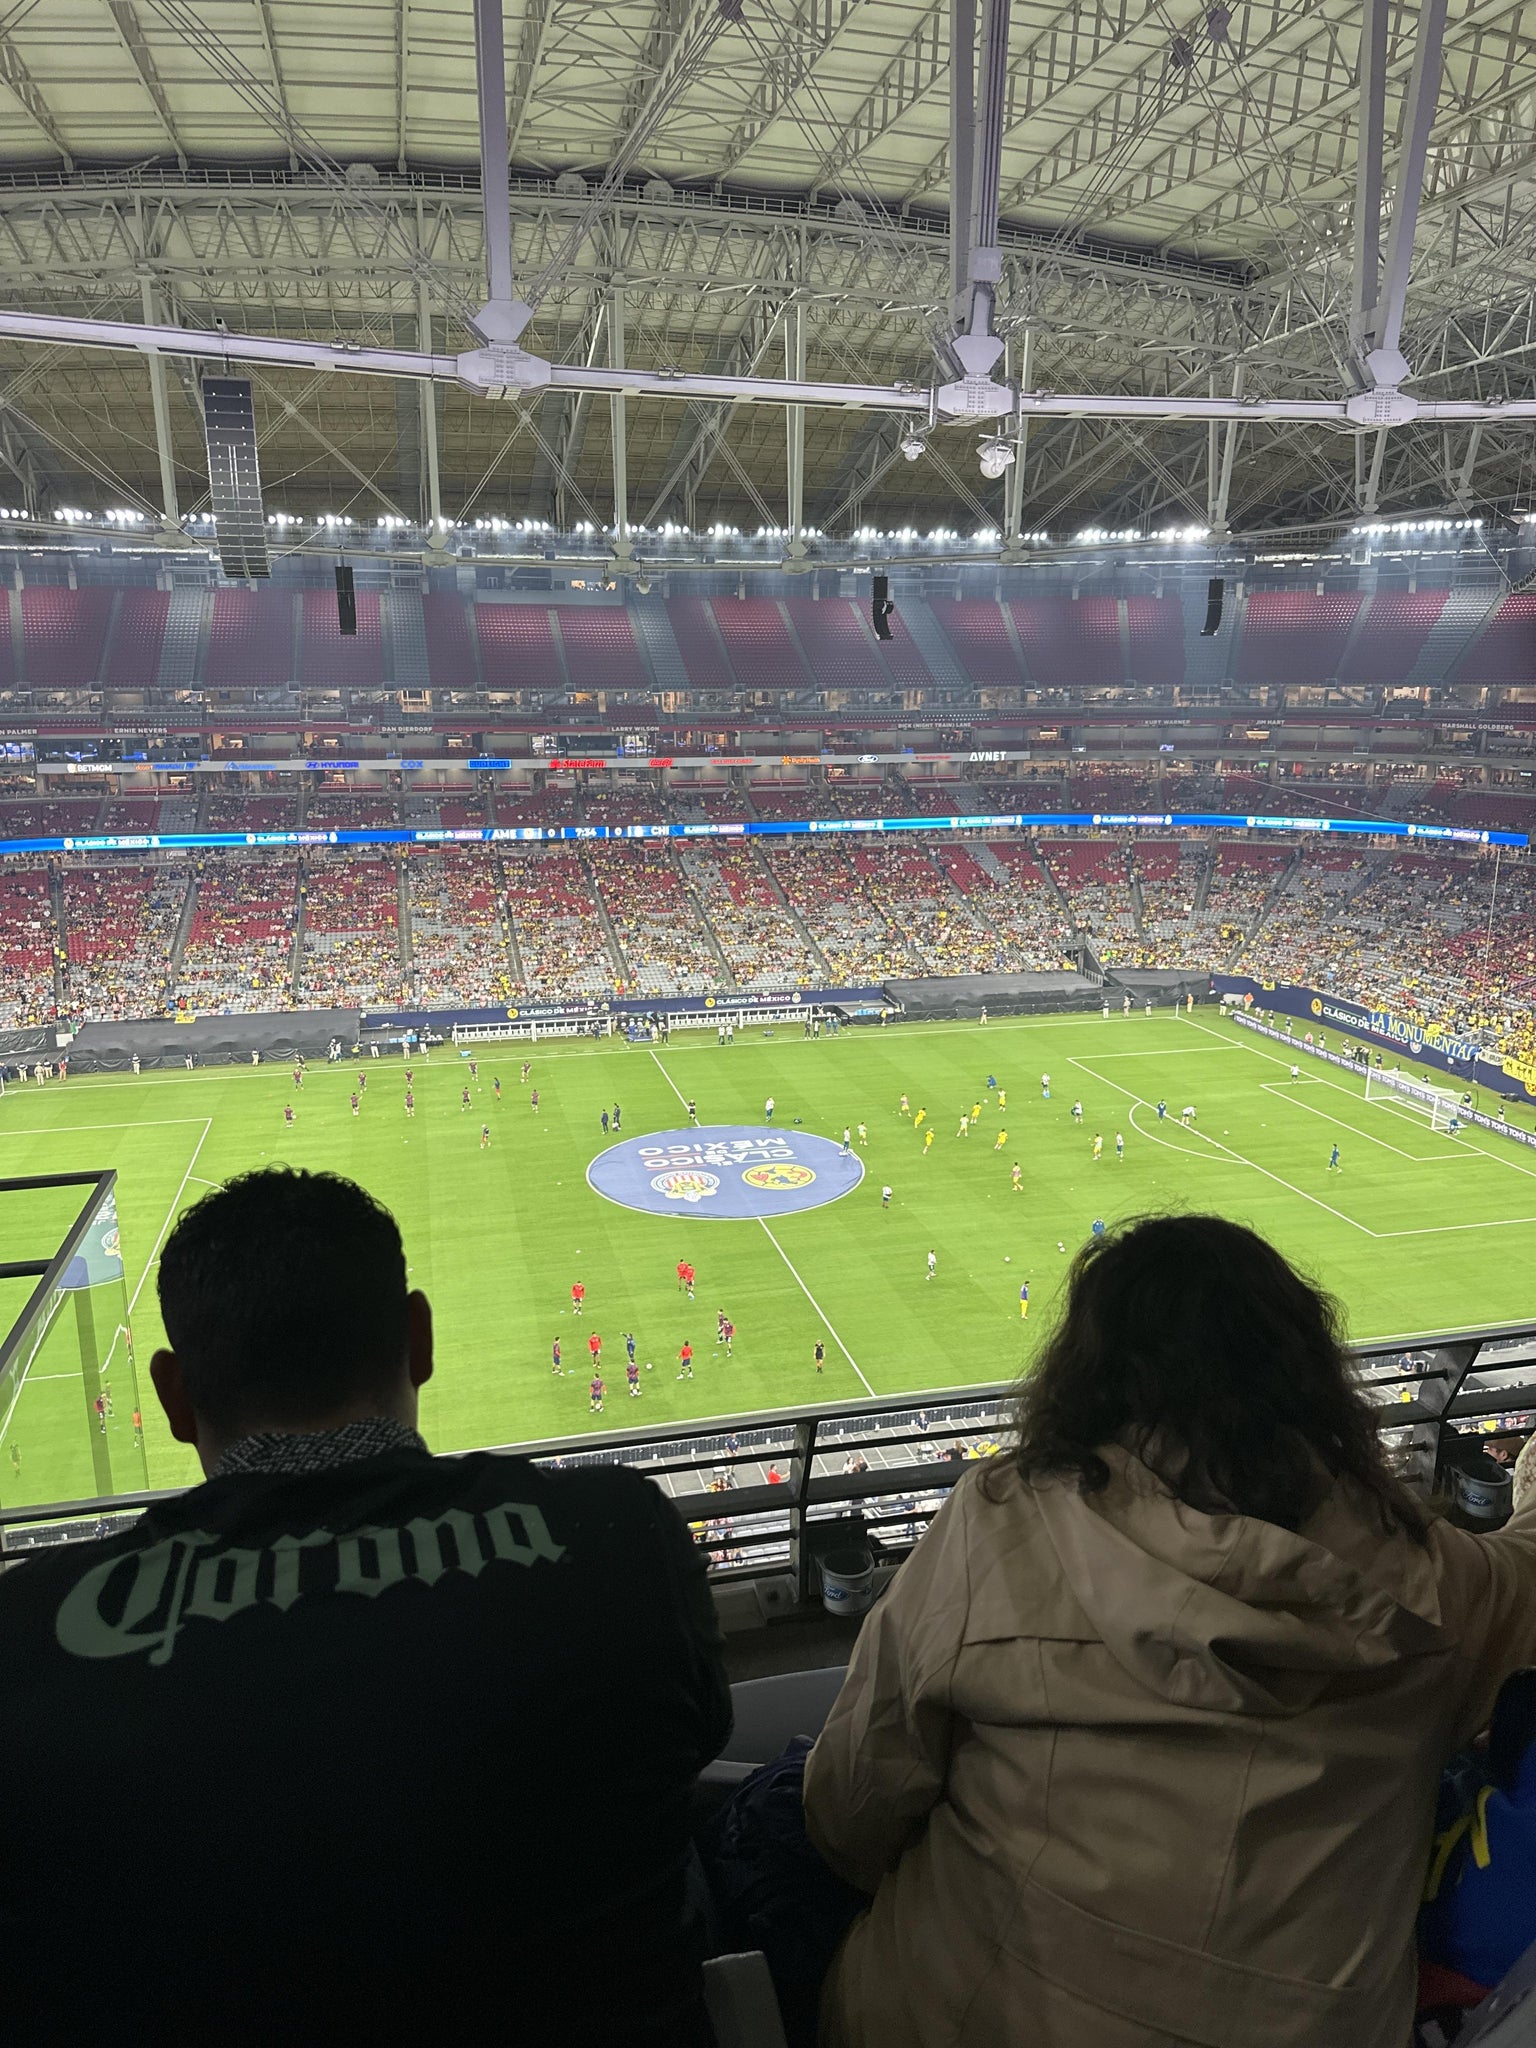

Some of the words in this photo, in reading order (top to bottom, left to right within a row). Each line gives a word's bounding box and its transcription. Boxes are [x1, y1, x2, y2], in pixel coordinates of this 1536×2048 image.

[77, 764, 113, 772] BETMGM
[320, 761, 360, 769] HYUNDAI
[400, 760, 424, 769] COX
[492, 829, 517, 840] AME
[548, 828, 556, 837] 0
[651, 825, 669, 835] CHI
[716, 997, 748, 1005] CLÁSICO
[759, 995, 791, 1003] MÉXICO
[519, 1007, 553, 1016] CLÁSICO
[1323, 1006, 1357, 1025] CLÁSICO
[1357, 1020, 1370, 1030] DE
[1371, 1013, 1386, 1029] LA
[637, 1137, 787, 1156] MÉXICO
[643, 1148, 794, 1168] CLÁSICO
[55, 1501, 567, 1667] Corona
[823, 1583, 842, 1599] Ford
